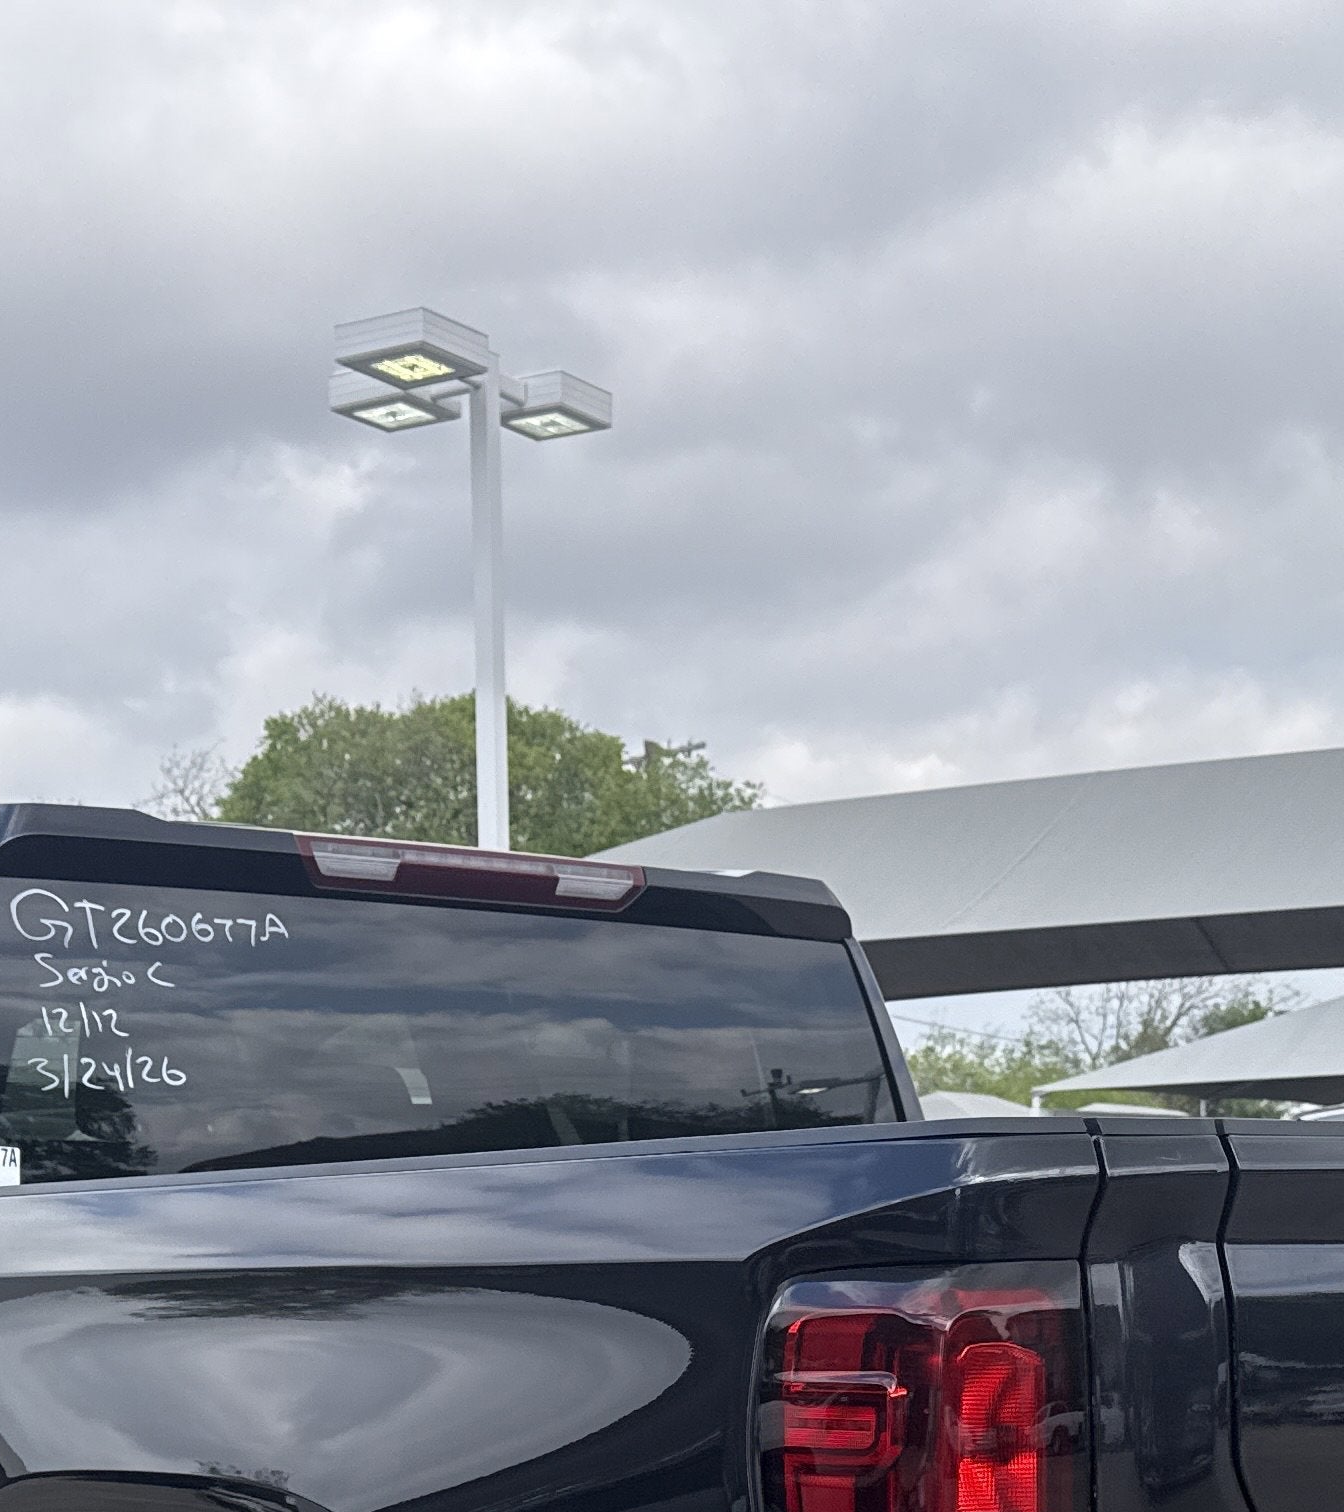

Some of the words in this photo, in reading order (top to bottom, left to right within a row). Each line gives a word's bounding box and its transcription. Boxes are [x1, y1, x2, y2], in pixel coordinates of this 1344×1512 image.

[10, 888, 289, 950] GT260677A
[147, 961, 176, 988] C
[41, 1001, 130, 1038] 12/12
[27, 1047, 187, 1099] 3/24/26
